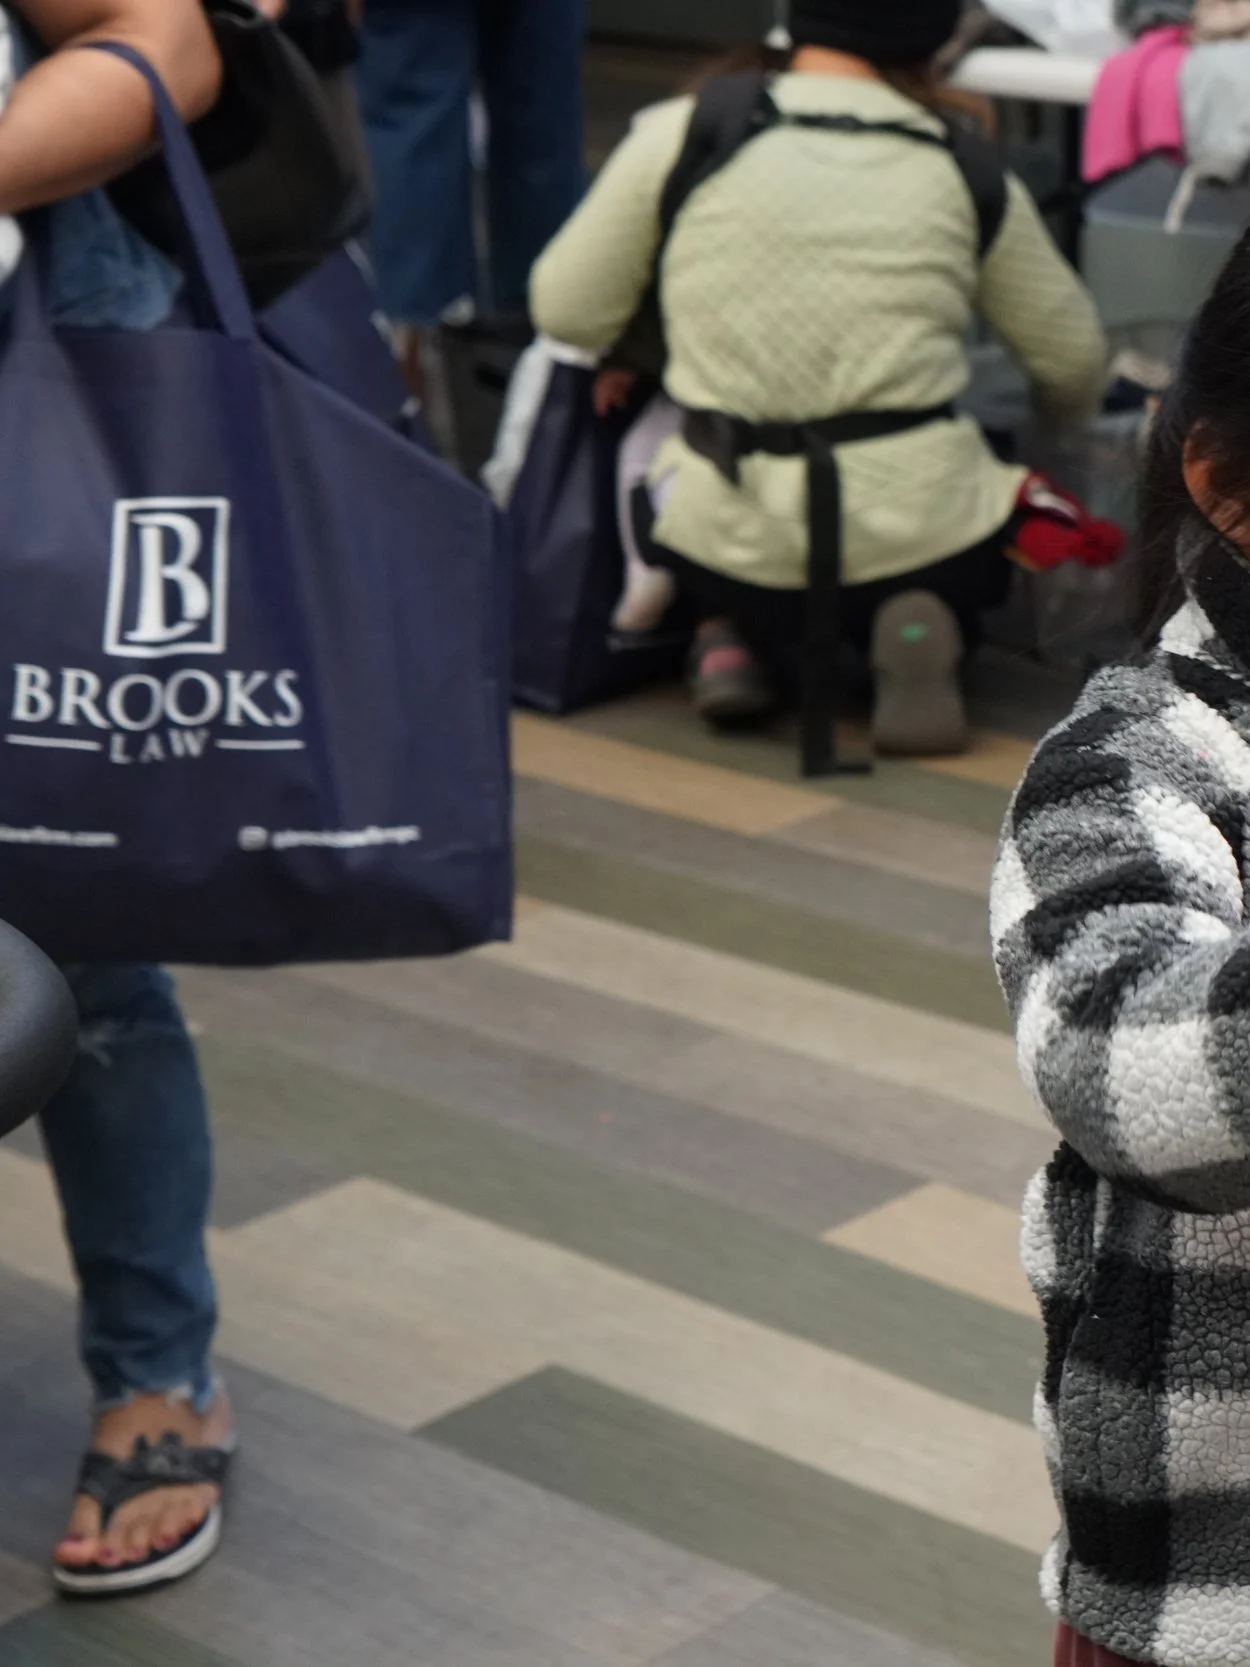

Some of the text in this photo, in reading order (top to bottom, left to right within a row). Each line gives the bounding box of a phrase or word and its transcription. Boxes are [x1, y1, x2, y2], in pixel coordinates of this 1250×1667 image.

[123, 512, 210, 642] B
[10, 663, 304, 731] BROOKS
[109, 728, 210, 764] LAW
